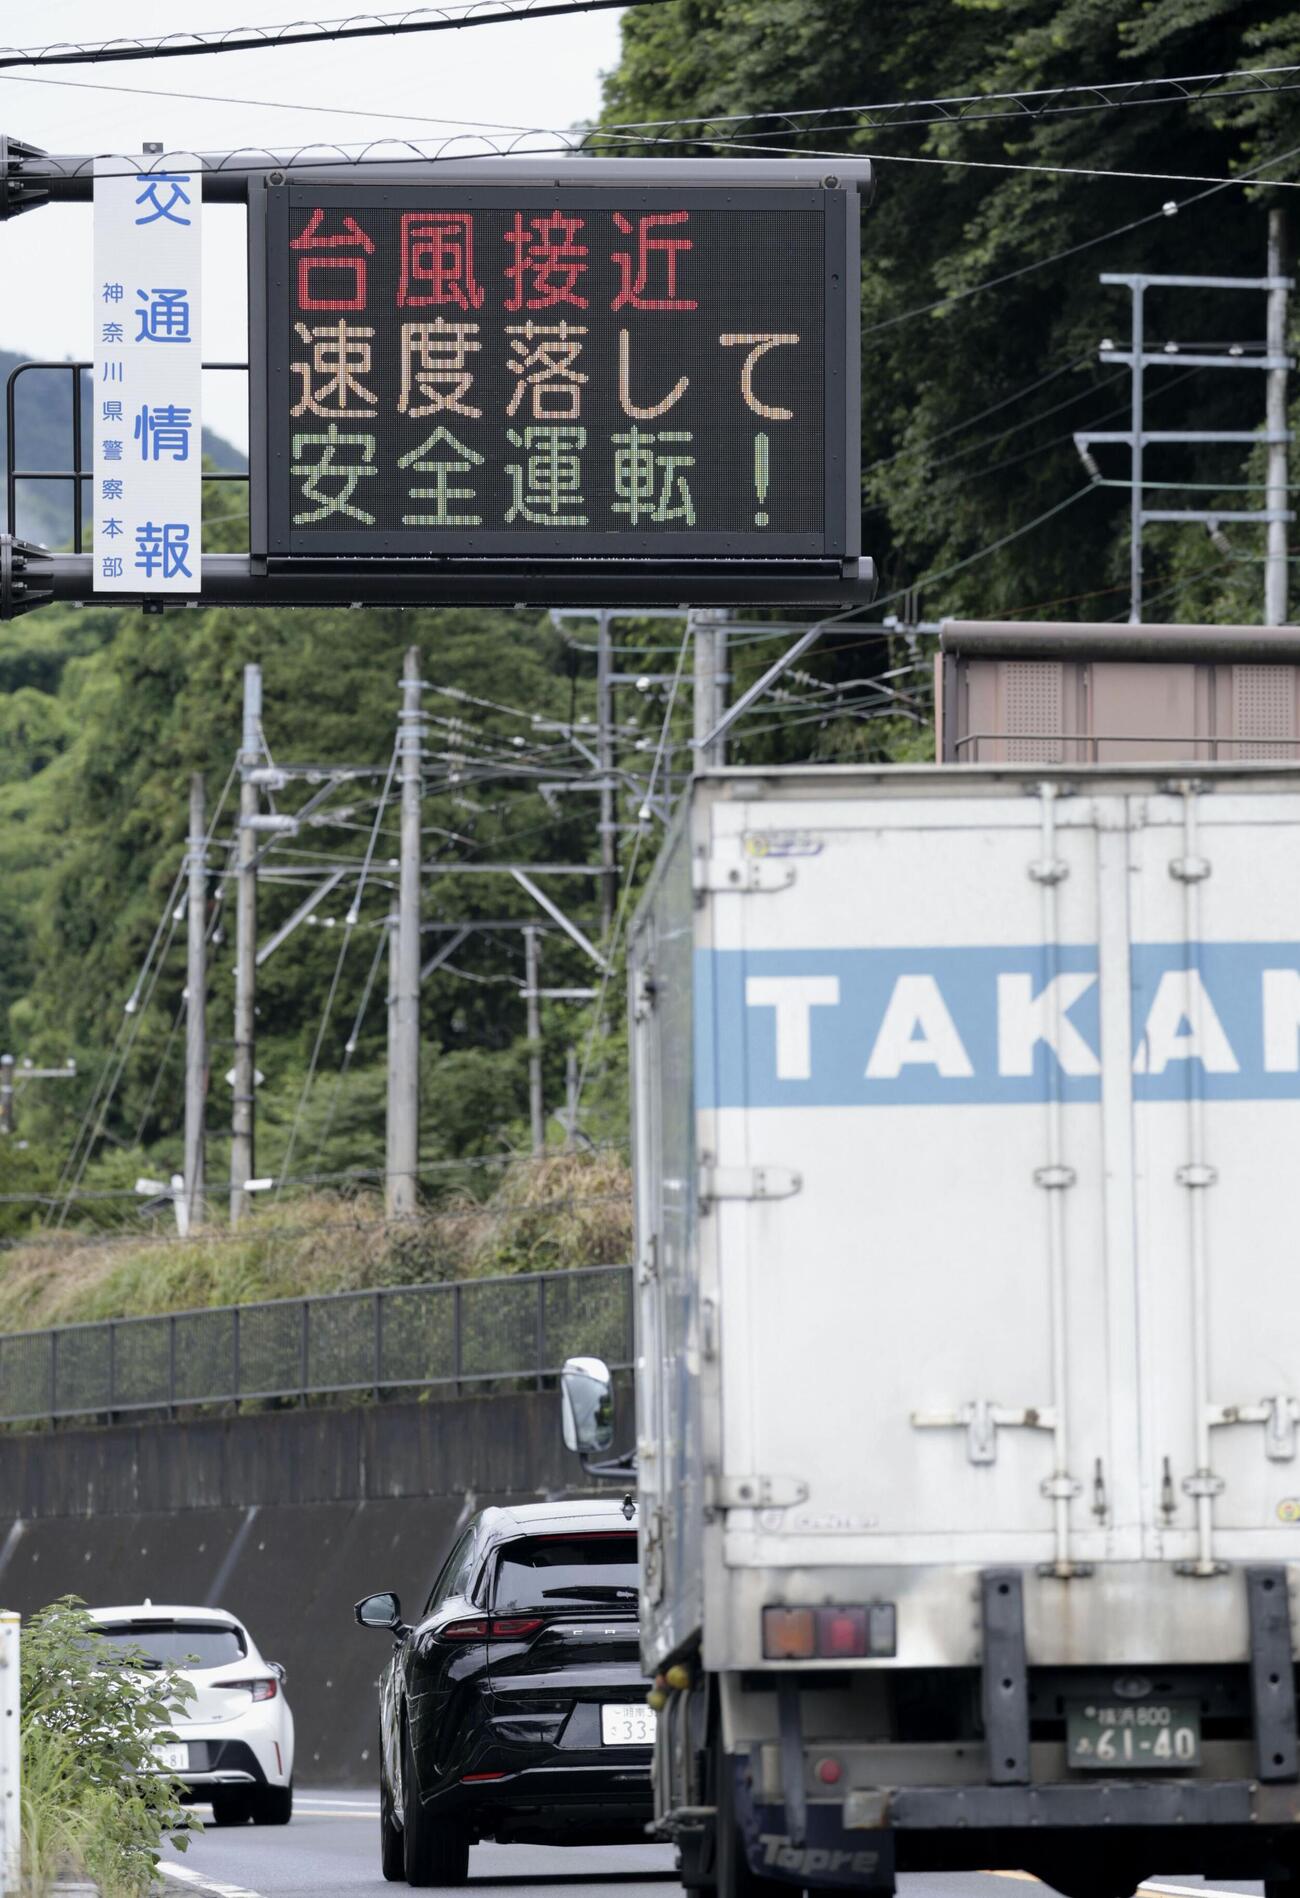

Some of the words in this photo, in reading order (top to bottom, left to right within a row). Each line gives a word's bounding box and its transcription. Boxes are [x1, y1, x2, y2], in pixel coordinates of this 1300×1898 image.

[289, 208, 699, 312] 台風接近
[134, 170, 193, 579] 交通情報
[289, 318, 800, 420] 速度落して
[102, 282, 124, 579] 神奈川県警察本部
[289, 425, 770, 528] 安全運転!
[623, 1720, 655, 1740] 33-
[1096, 1727, 1196, 1760] 61-40
